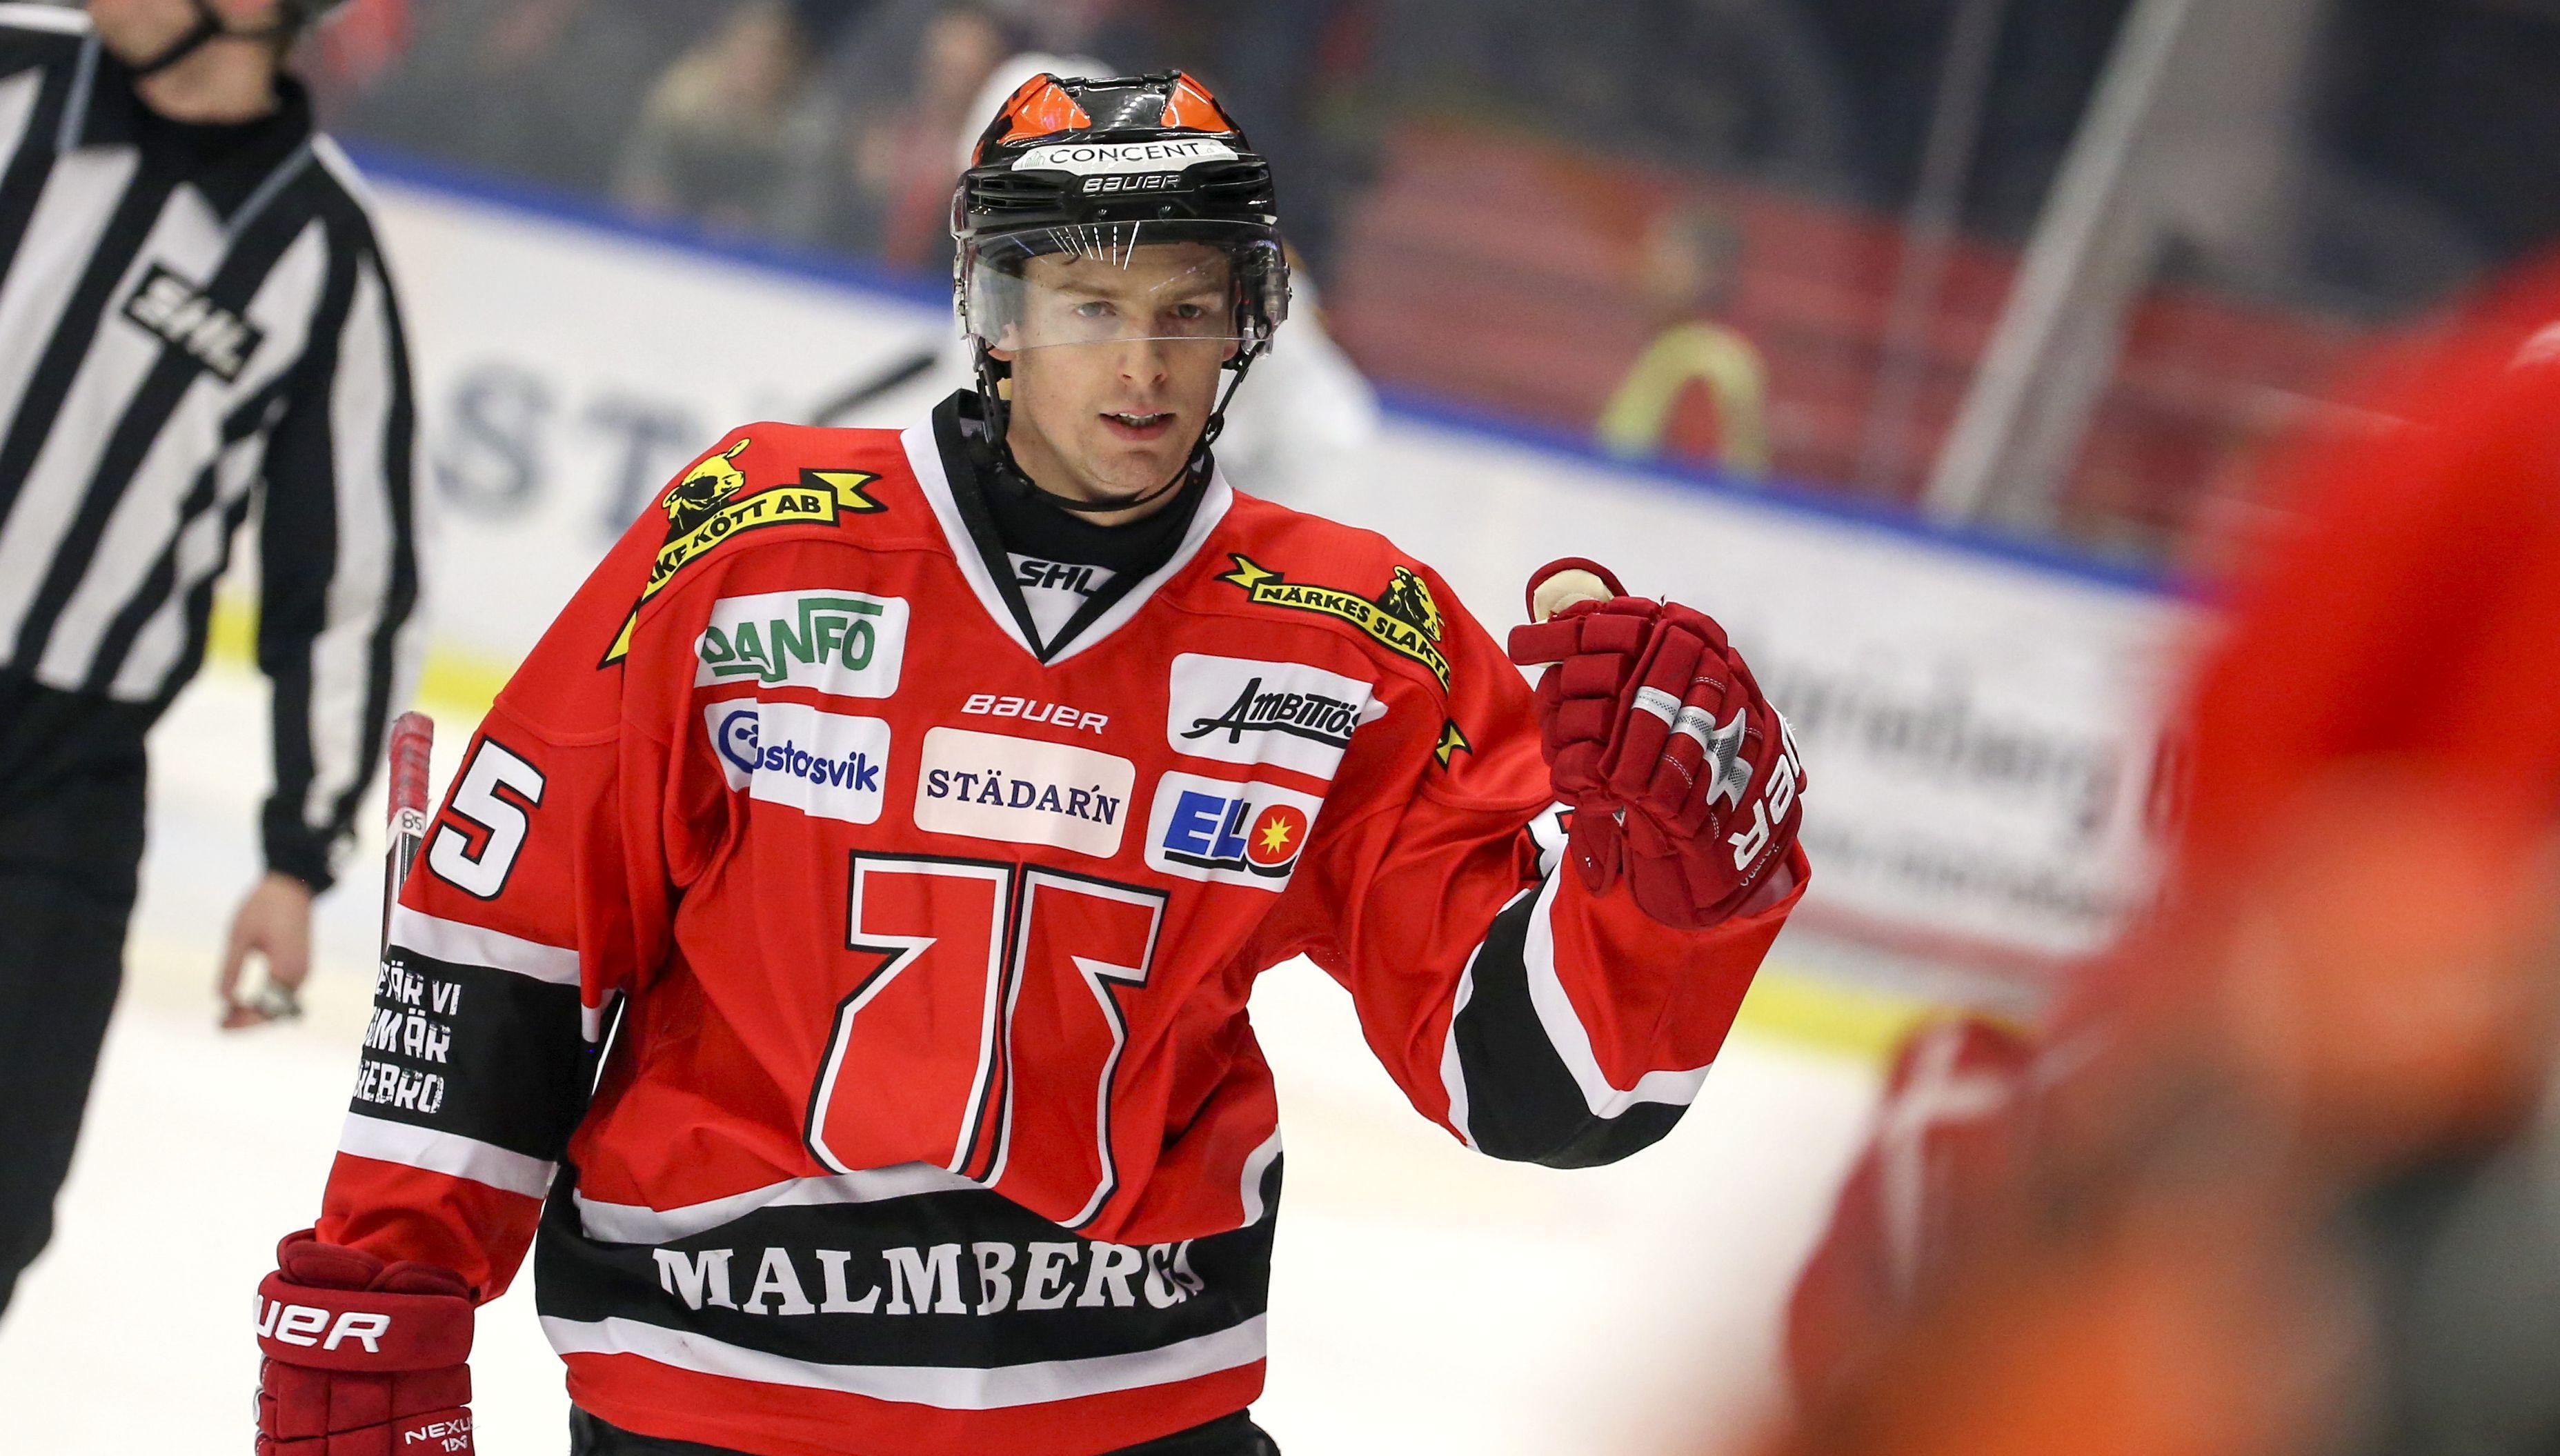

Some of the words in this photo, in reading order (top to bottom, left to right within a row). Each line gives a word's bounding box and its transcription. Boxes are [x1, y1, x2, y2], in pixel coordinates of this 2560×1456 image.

[1049, 141, 1200, 166] CONCENT
[1082, 173, 1182, 193] BAUER
[691, 497, 767, 549] KÖTT
[775, 494, 821, 515] AB
[1016, 559, 1099, 595] SHL
[1260, 586, 1371, 623] NÄRKES
[700, 597, 884, 684] DANFO
[960, 692, 1109, 735] BAUER
[426, 735, 547, 901] 5
[431, 979, 462, 1016] VI
[404, 1416, 473, 1445] NEXU
